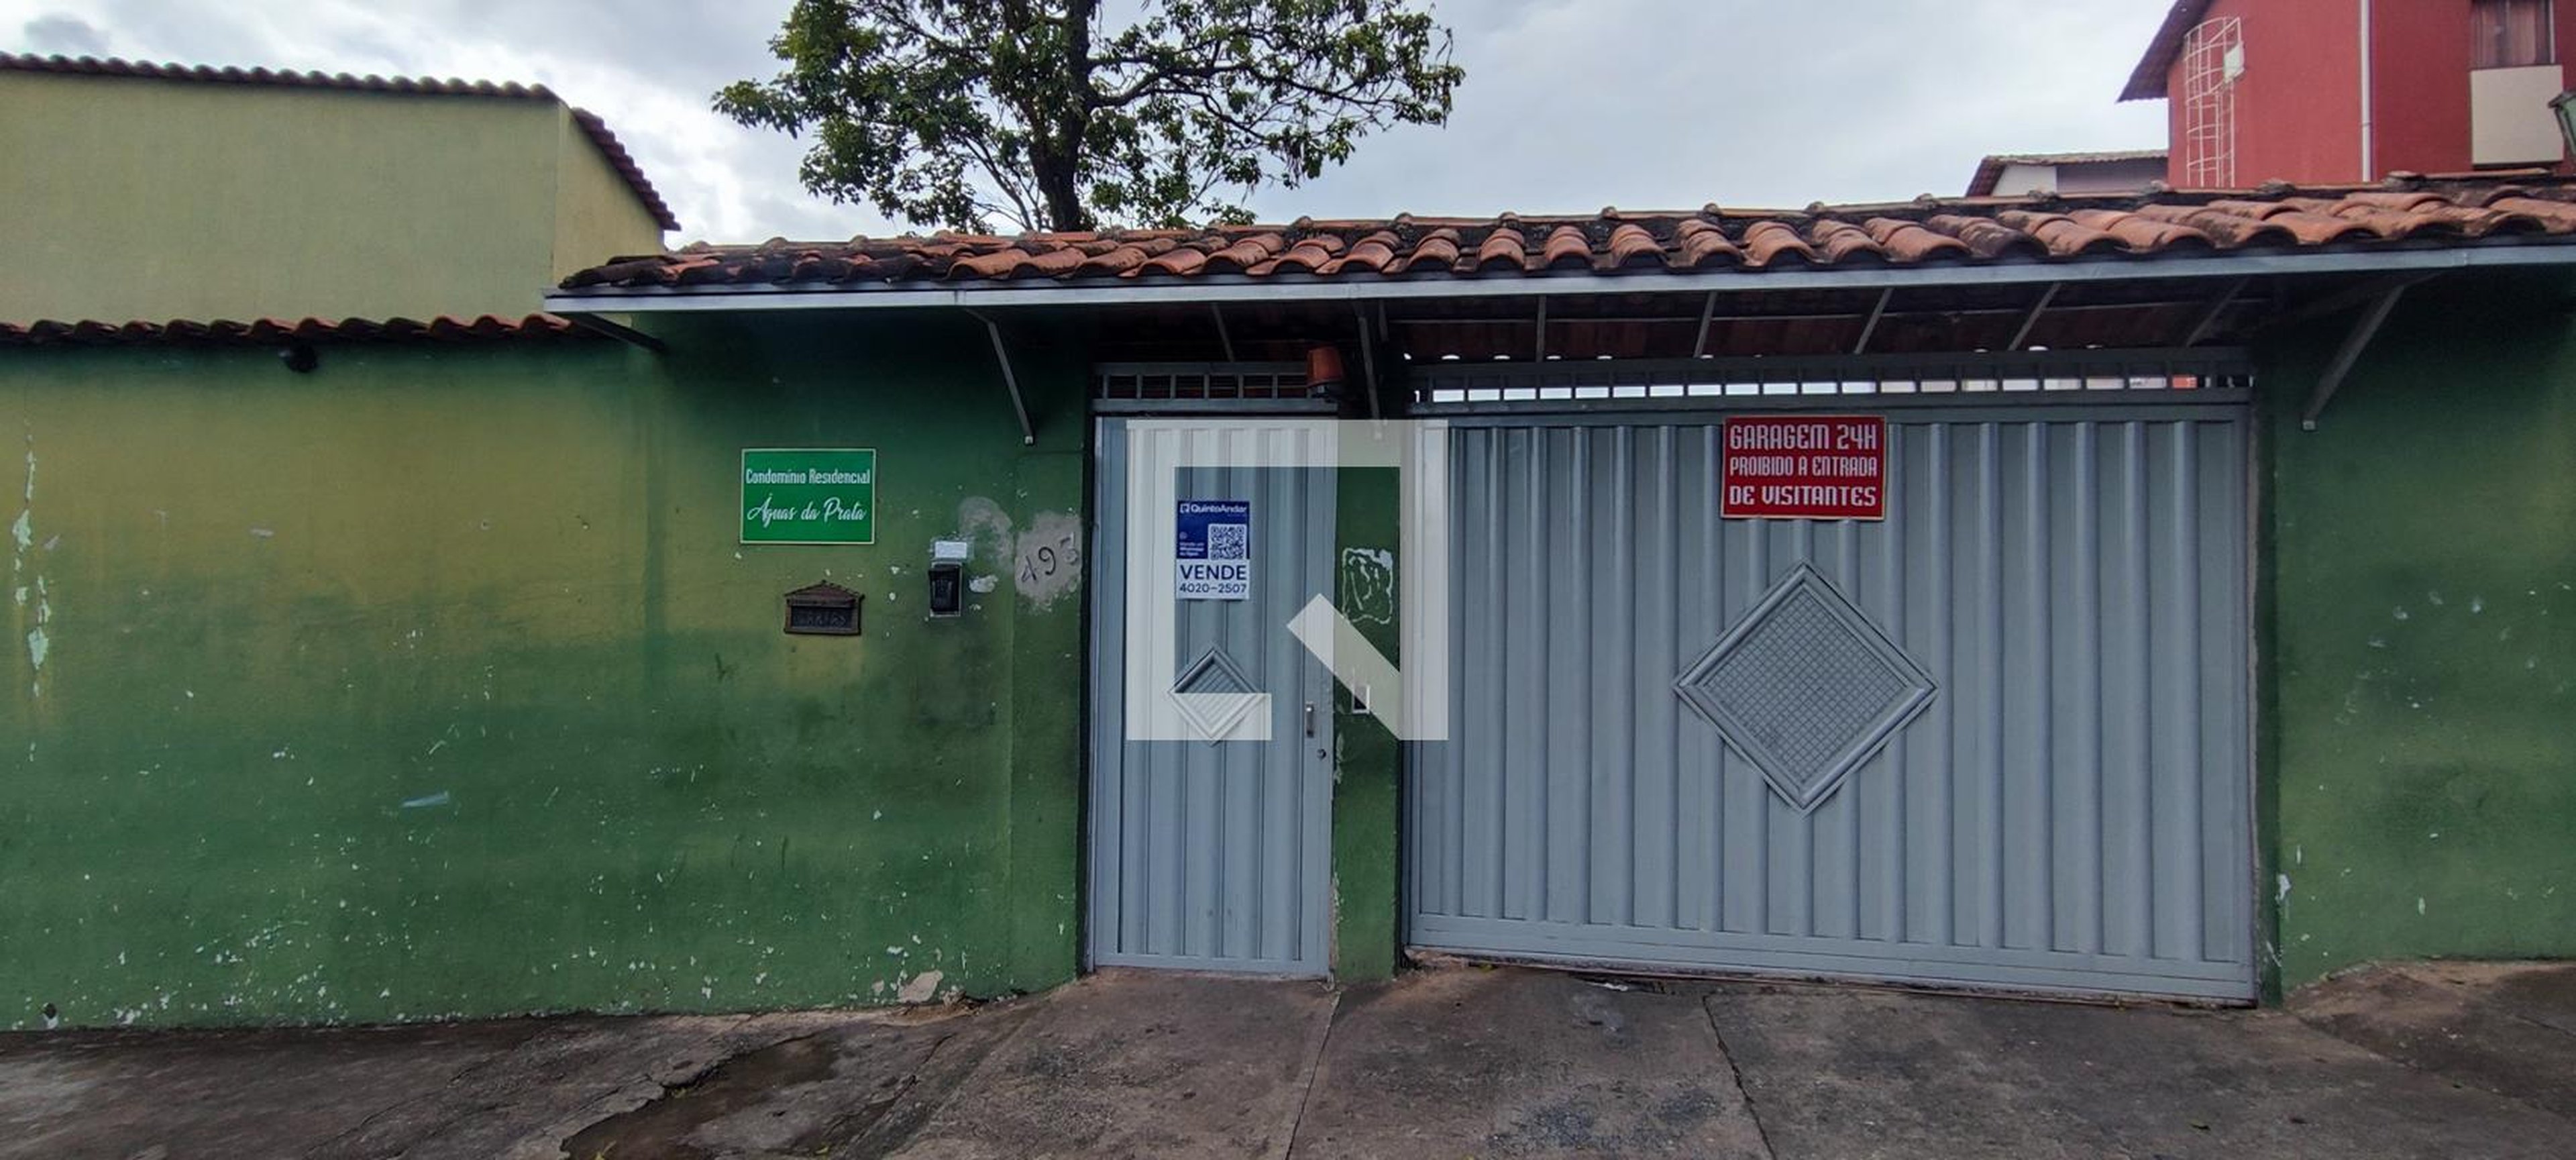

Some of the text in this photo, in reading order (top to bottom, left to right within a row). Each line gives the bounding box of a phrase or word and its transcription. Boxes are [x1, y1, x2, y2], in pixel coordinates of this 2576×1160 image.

[1729, 424, 1877, 450] GARAGEM 24H
[1730, 456, 1878, 477] PROIBIDO A ENTRADA
[809, 468, 871, 484] Residencial
[1729, 485, 1876, 507] DE VISITANTES
[747, 492, 868, 528] Águas da Prata
[1191, 503, 1247, 513] QuintoAndar
[1179, 564, 1247, 580] VENDE
[1179, 582, 1247, 594] 4020-2507
